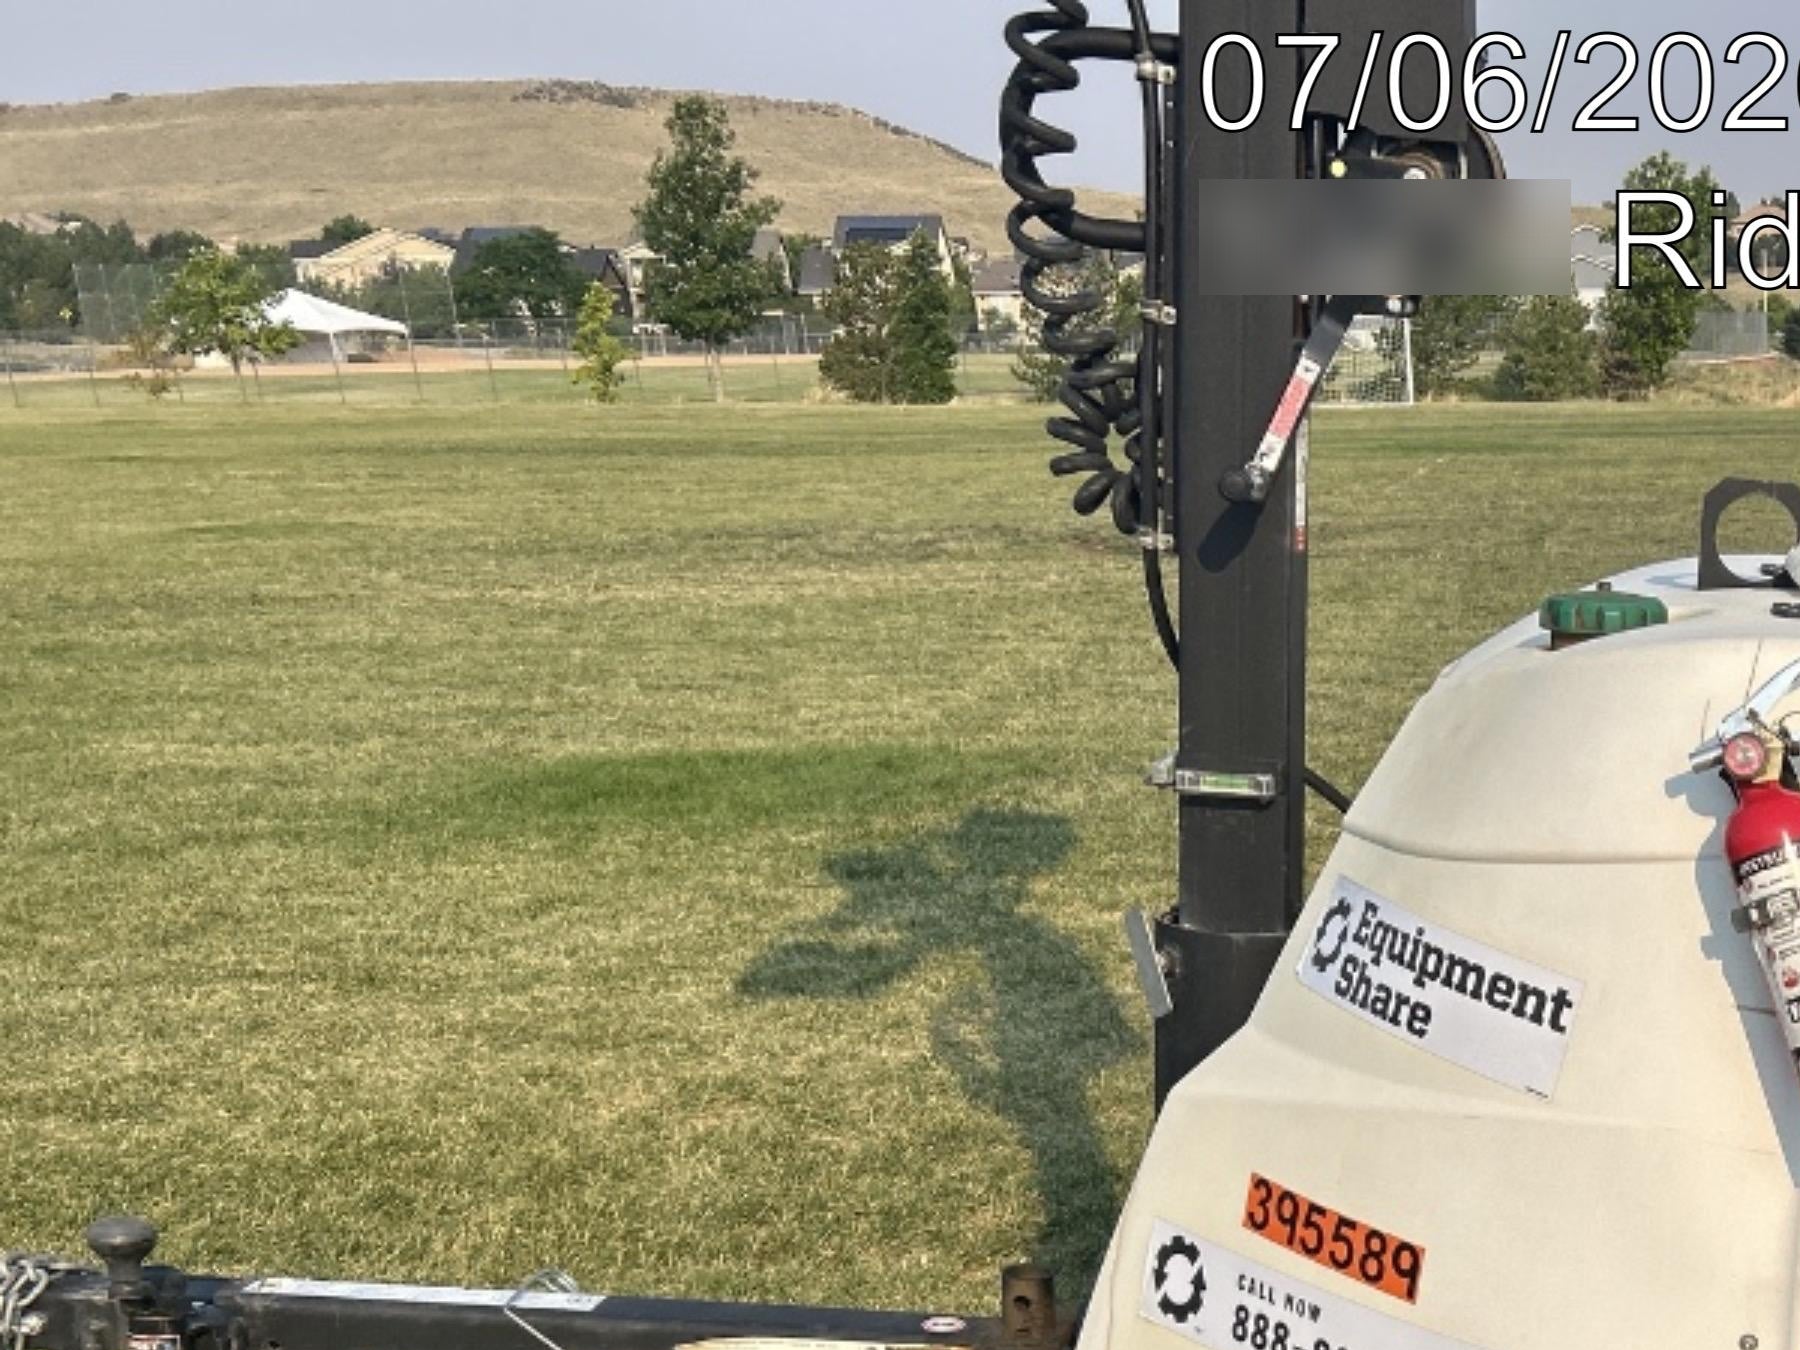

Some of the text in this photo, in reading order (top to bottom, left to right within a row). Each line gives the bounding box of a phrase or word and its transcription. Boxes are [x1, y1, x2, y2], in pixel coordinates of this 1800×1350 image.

[1333, 954, 1432, 1039] Share
[1352, 899, 1573, 1034] Equipment
[1249, 1177, 1421, 1301] 395589
[1237, 1273, 1322, 1324] CALL NOW
